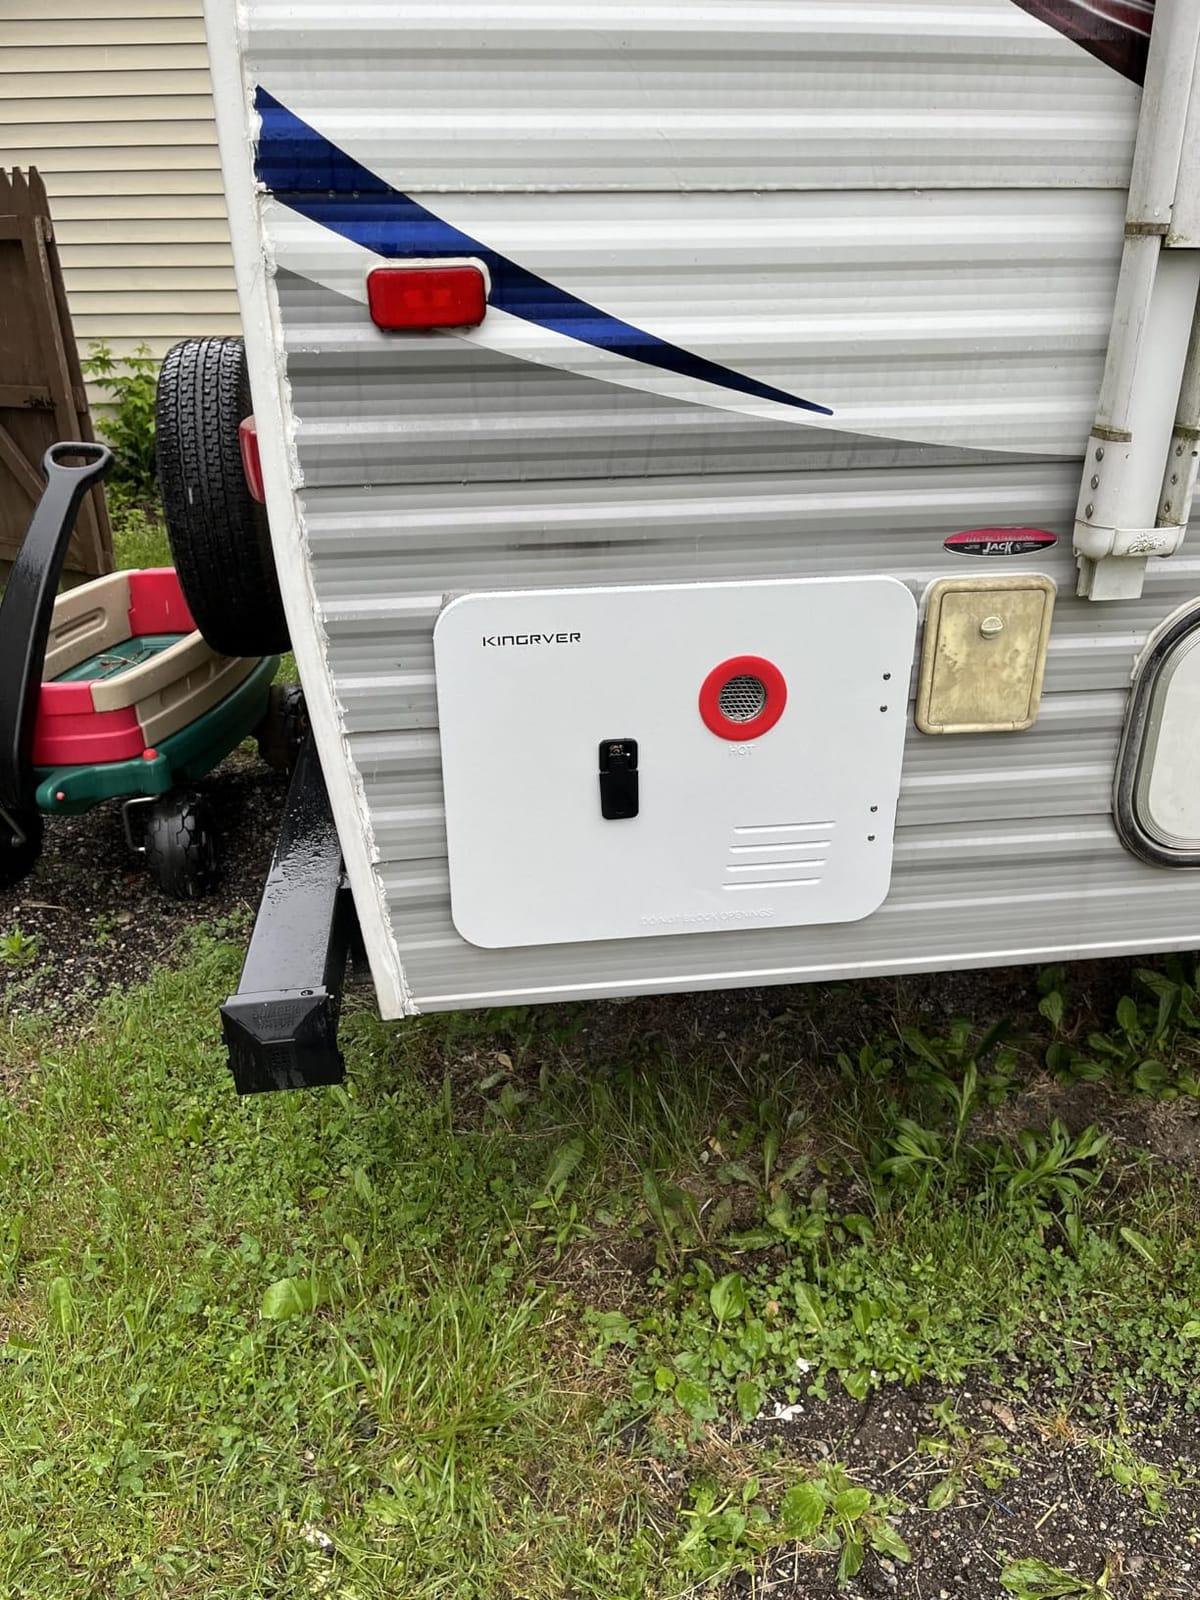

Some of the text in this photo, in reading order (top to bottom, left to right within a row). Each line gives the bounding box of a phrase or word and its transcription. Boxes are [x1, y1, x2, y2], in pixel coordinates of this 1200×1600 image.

[982, 541, 1014, 555] JACK
[482, 632, 581, 647] KINGRVER
[728, 744, 755, 756] HOT
